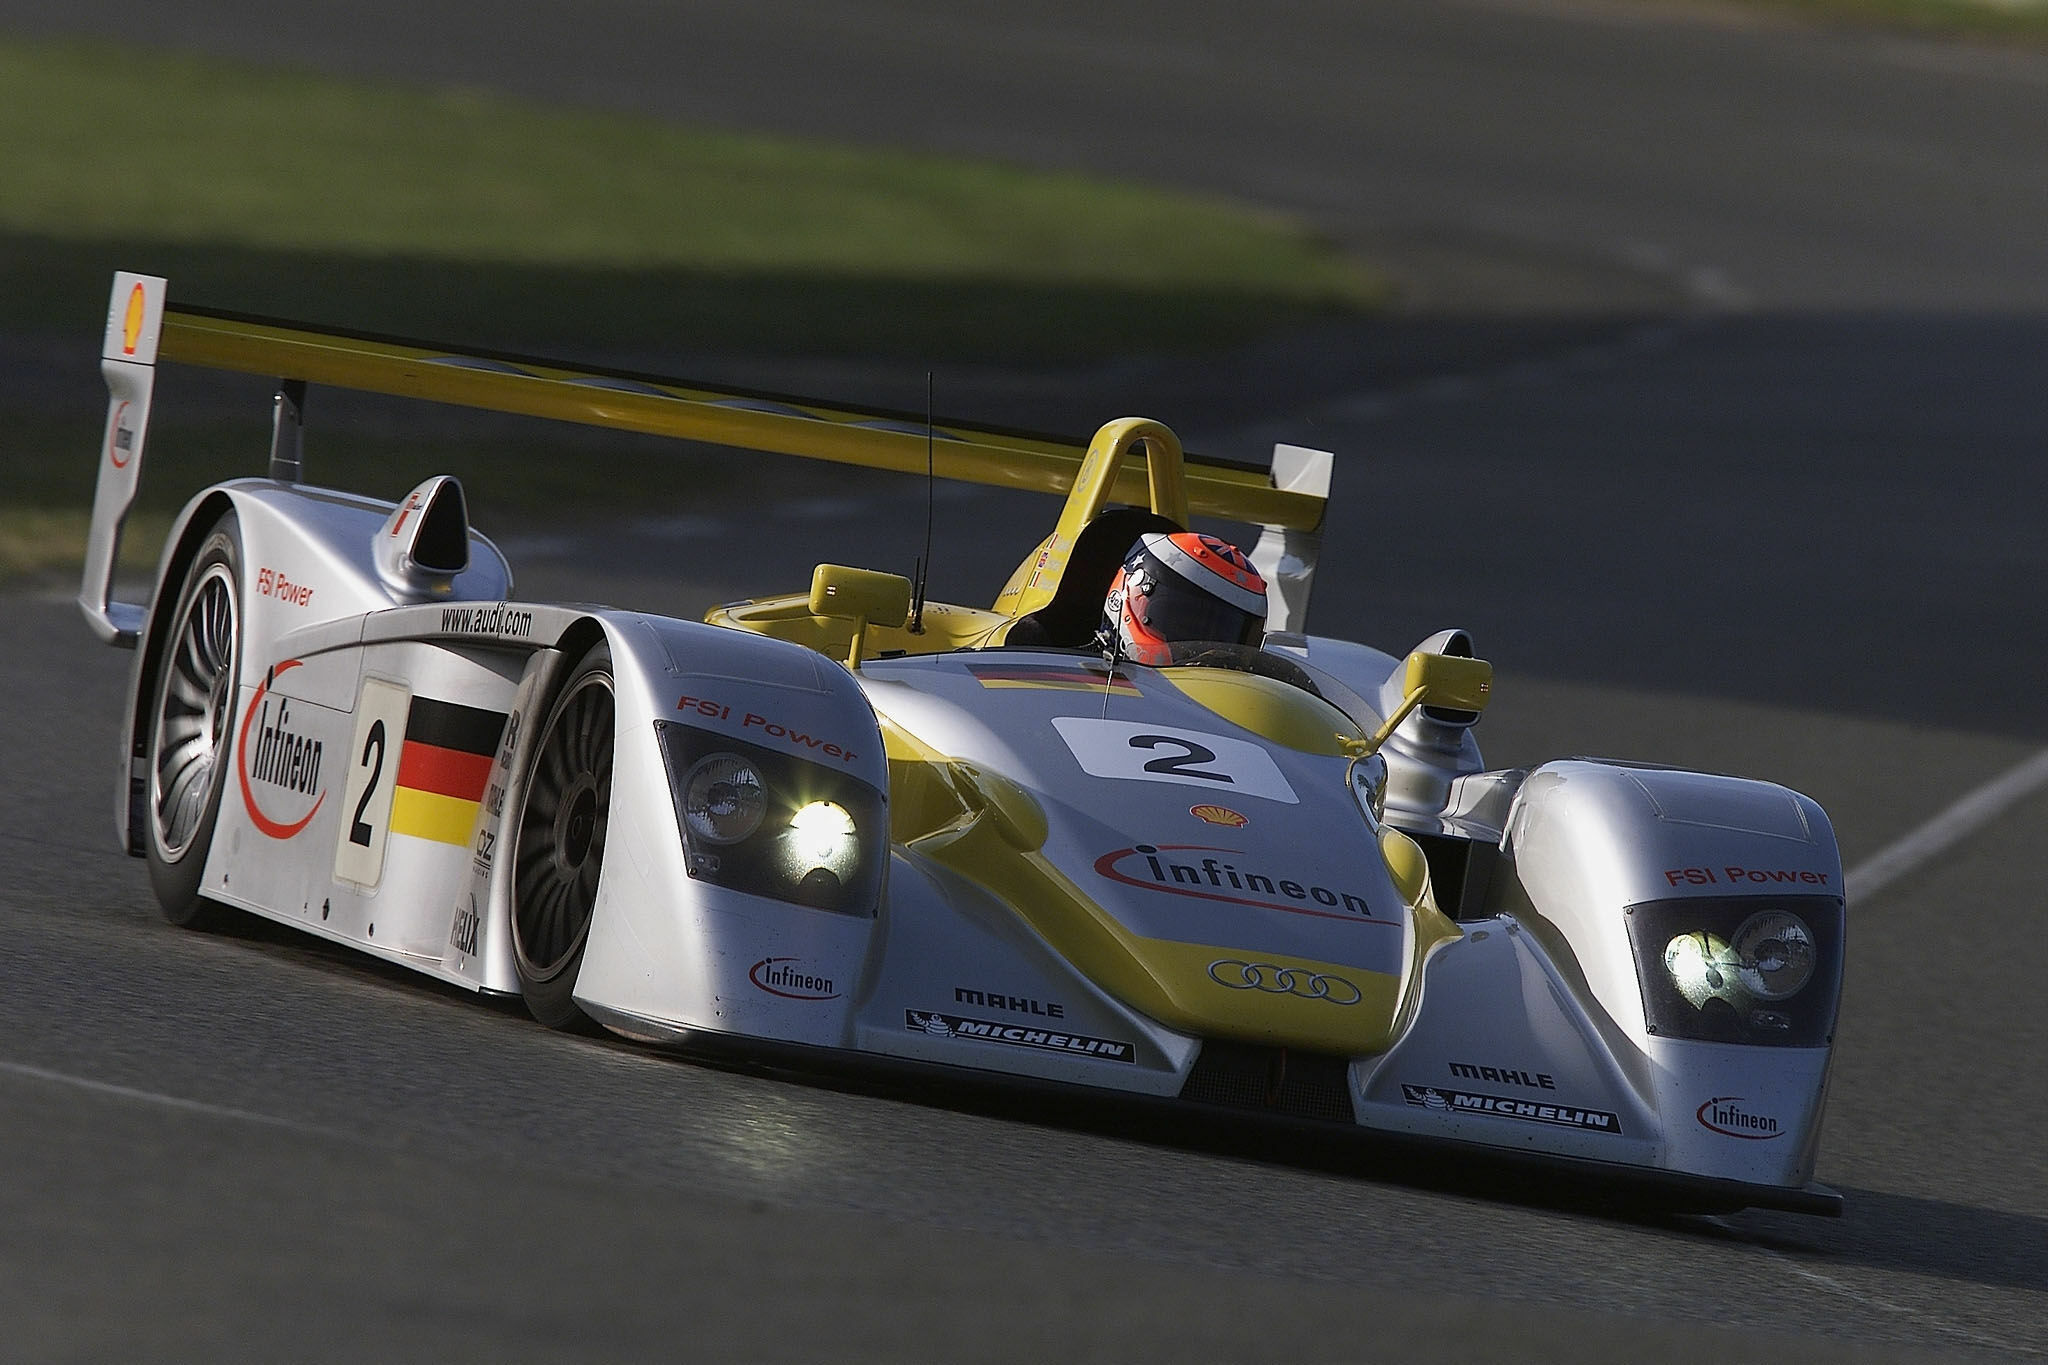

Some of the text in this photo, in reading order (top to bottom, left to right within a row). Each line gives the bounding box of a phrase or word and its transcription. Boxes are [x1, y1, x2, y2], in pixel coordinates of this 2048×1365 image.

[255, 567, 313, 607] FSI Power
[441, 602, 532, 637] www.audi.com
[252, 665, 322, 796] Infineon
[676, 695, 858, 763] FSI Power
[1128, 735, 1235, 784] 2
[349, 719, 386, 848] 2
[476, 828, 496, 861] OZ
[1135, 844, 1372, 916] Infineon
[1664, 866, 1829, 888] FSI Power
[449, 893, 479, 957] HELIX
[764, 957, 833, 994] Infineon
[954, 987, 1065, 1019] MAHLE
[957, 1020, 1125, 1057] MICHELIN
[1448, 1061, 1556, 1090] MAHLE
[1452, 1094, 1610, 1127] MICHELIN
[1712, 1097, 1777, 1132] Infineon
